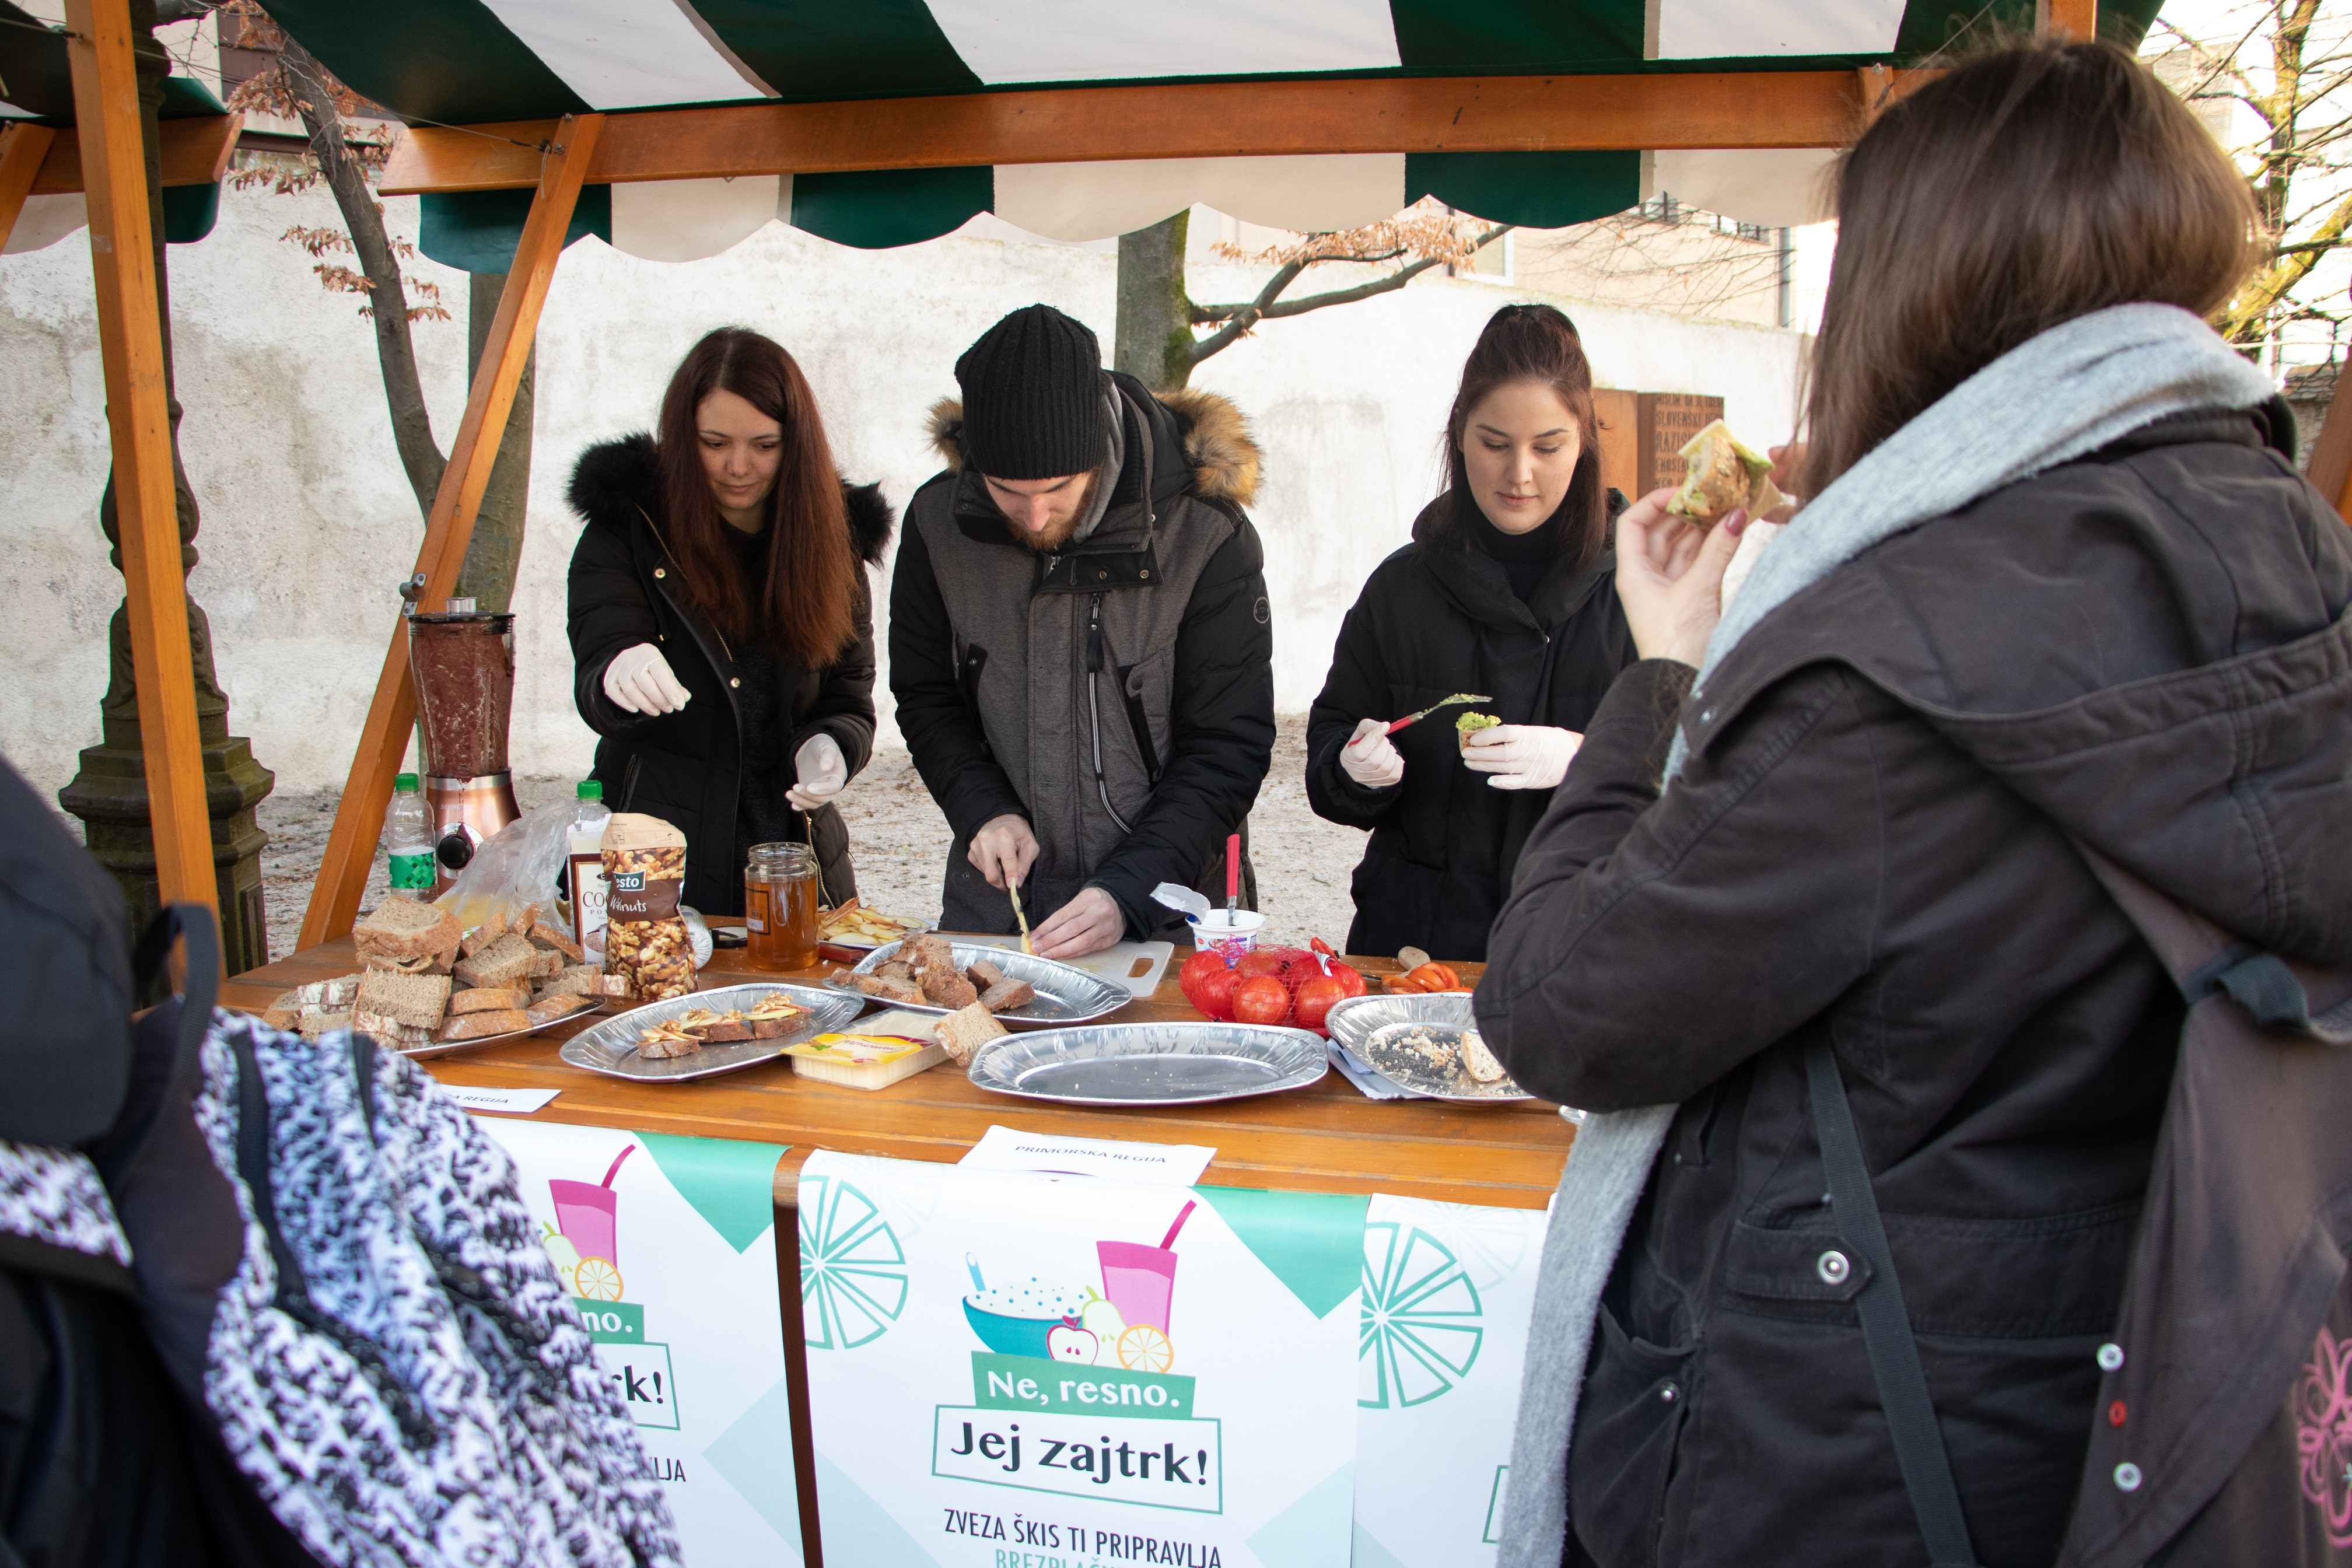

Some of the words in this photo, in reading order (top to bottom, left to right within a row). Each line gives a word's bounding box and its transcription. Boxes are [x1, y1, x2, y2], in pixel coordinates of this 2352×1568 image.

[614, 875, 640, 888] esto
[583, 891, 608, 908] CO
[610, 894, 647, 912] Walnuts
[1015, 1146, 1108, 1157] PRIMORSKA
[1113, 1154, 1166, 1163] REGIJA
[987, 1370, 1049, 1406] Ne,
[1059, 1380, 1180, 1407] resno.
[951, 1422, 1021, 1472] Jej
[1038, 1436, 1208, 1486] zajtrk!
[649, 1456, 687, 1482] LJA
[944, 1508, 1007, 1541] ZVEZA
[1014, 1513, 1060, 1548] ŠKIS
[1068, 1526, 1086, 1553] TI
[1096, 1530, 1222, 1568] PRIPRAVLJA
